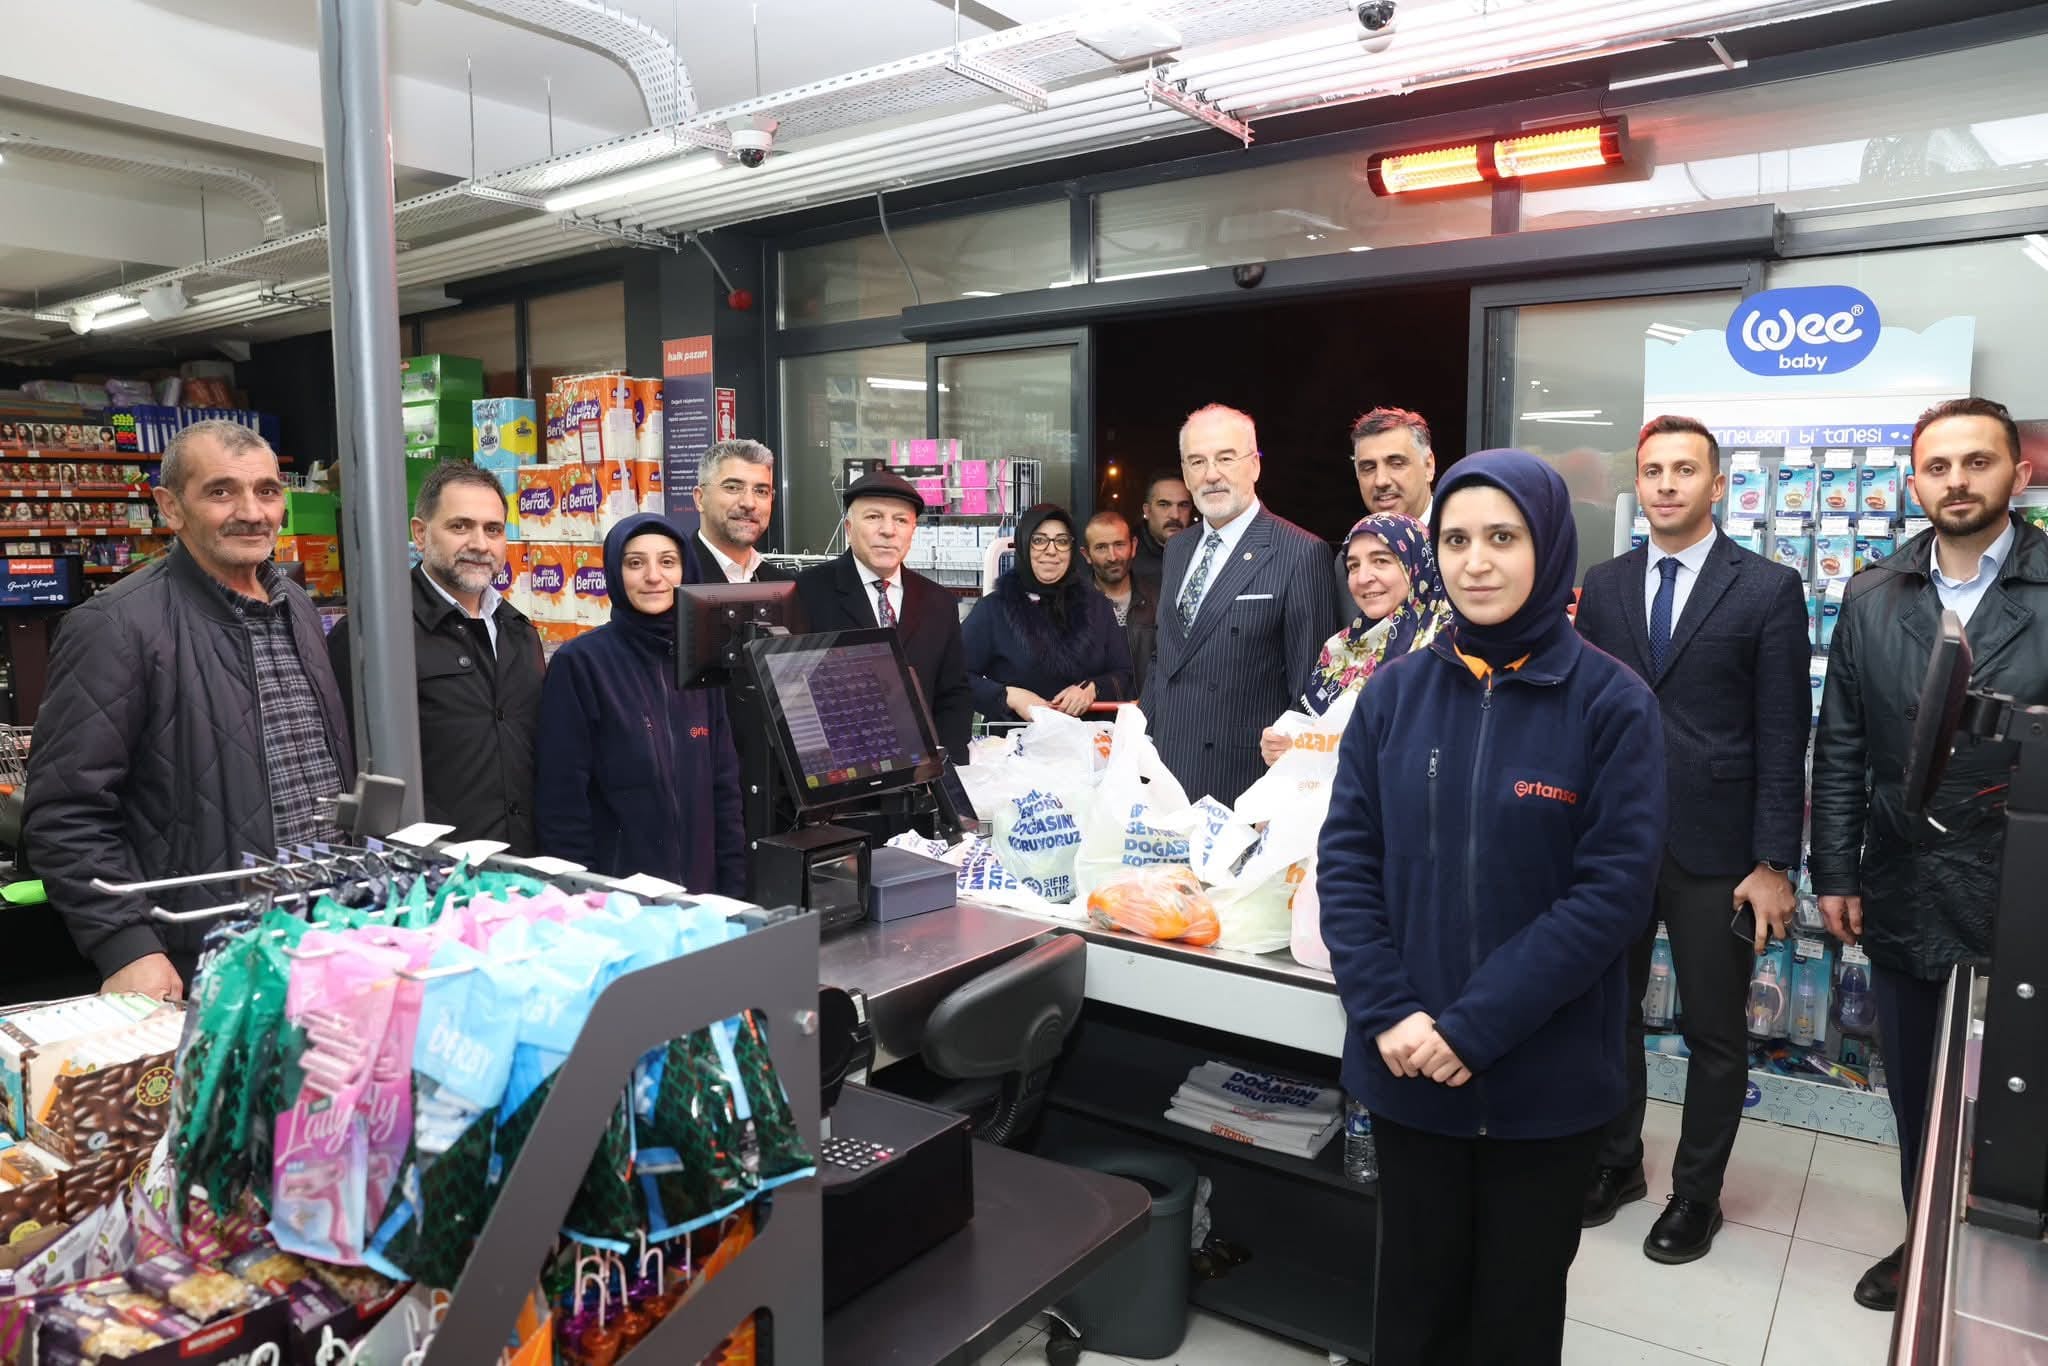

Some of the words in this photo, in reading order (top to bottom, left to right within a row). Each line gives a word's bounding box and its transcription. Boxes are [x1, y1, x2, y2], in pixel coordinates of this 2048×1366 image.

[1778, 353, 1828, 371] baby
[520, 494, 551, 512] Berrak
[532, 572, 560, 588] Berrak
[1043, 874, 1070, 888] SIFIR
